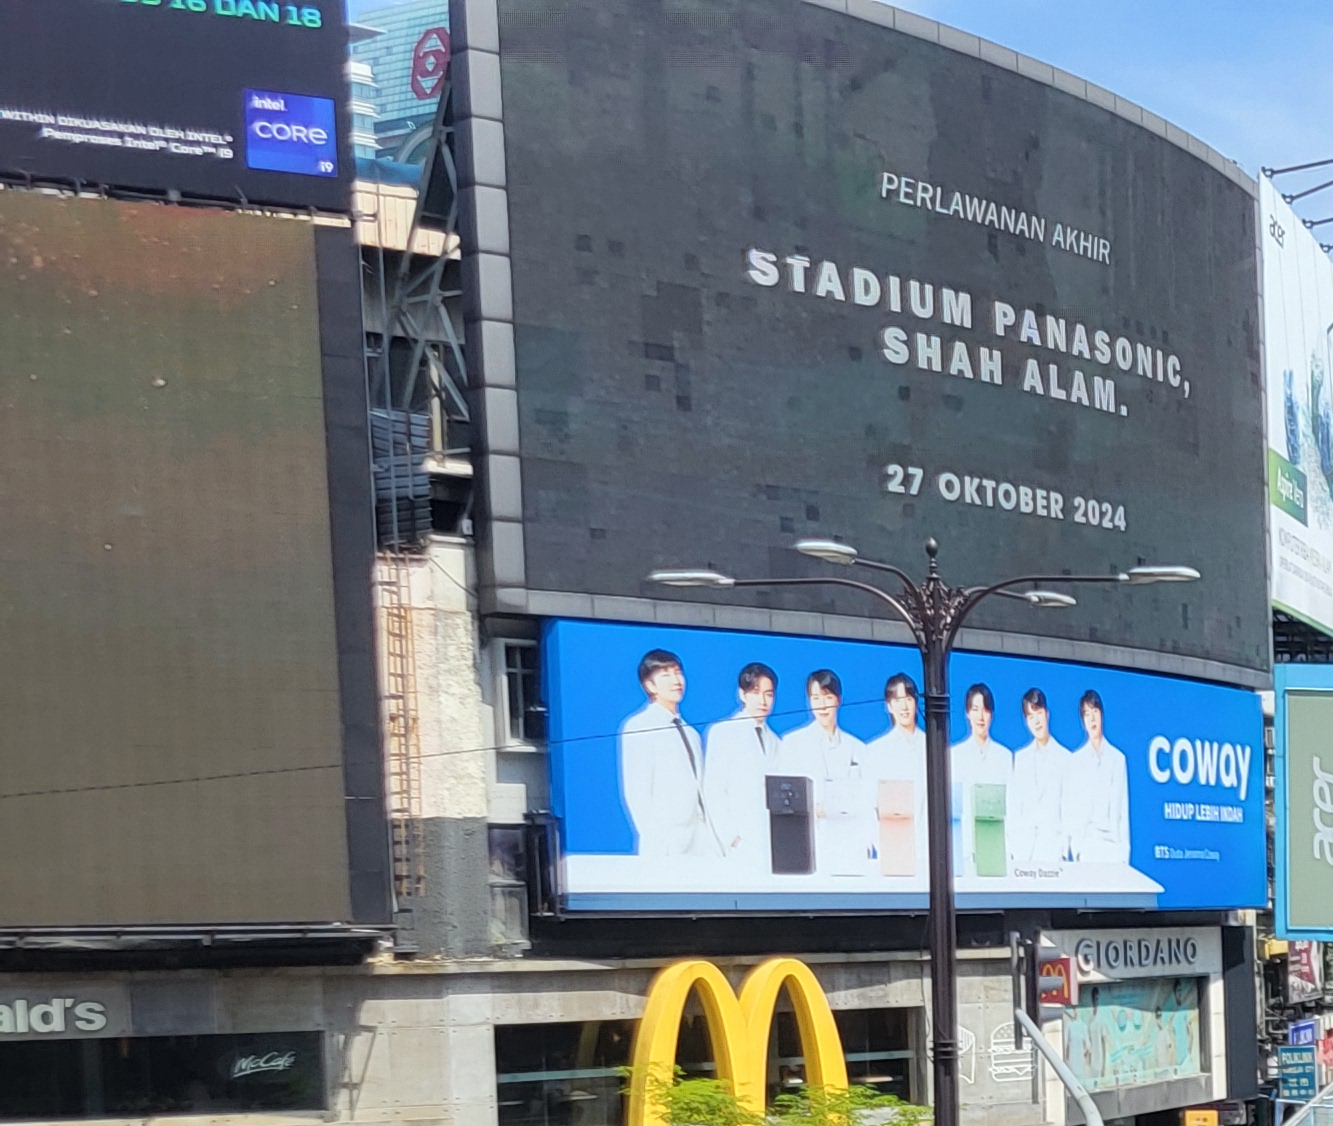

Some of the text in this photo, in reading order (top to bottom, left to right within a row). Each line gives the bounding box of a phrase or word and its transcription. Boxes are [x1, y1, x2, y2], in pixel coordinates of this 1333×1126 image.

[215, 0, 280, 23] DAN
[287, 5, 322, 28] 18
[150, 125, 185, 139] OLEH
[320, 160, 334, 174] i9
[881, 172, 1111, 265] PERLAWANAN AKHIR
[748, 249, 1190, 399] STADIUM PANASONIC,
[882, 326, 1128, 417] SHAH ALAM.
[886, 464, 1127, 532] 27 OKTOBER 2024
[1164, 802, 1194, 820] HIDUP
[1195, 804, 1219, 821] LEBIH
[1154, 845, 1170, 859] BTS
[1014, 868, 1038, 879] Coway
[1075, 936, 1200, 977] GIORDANO
